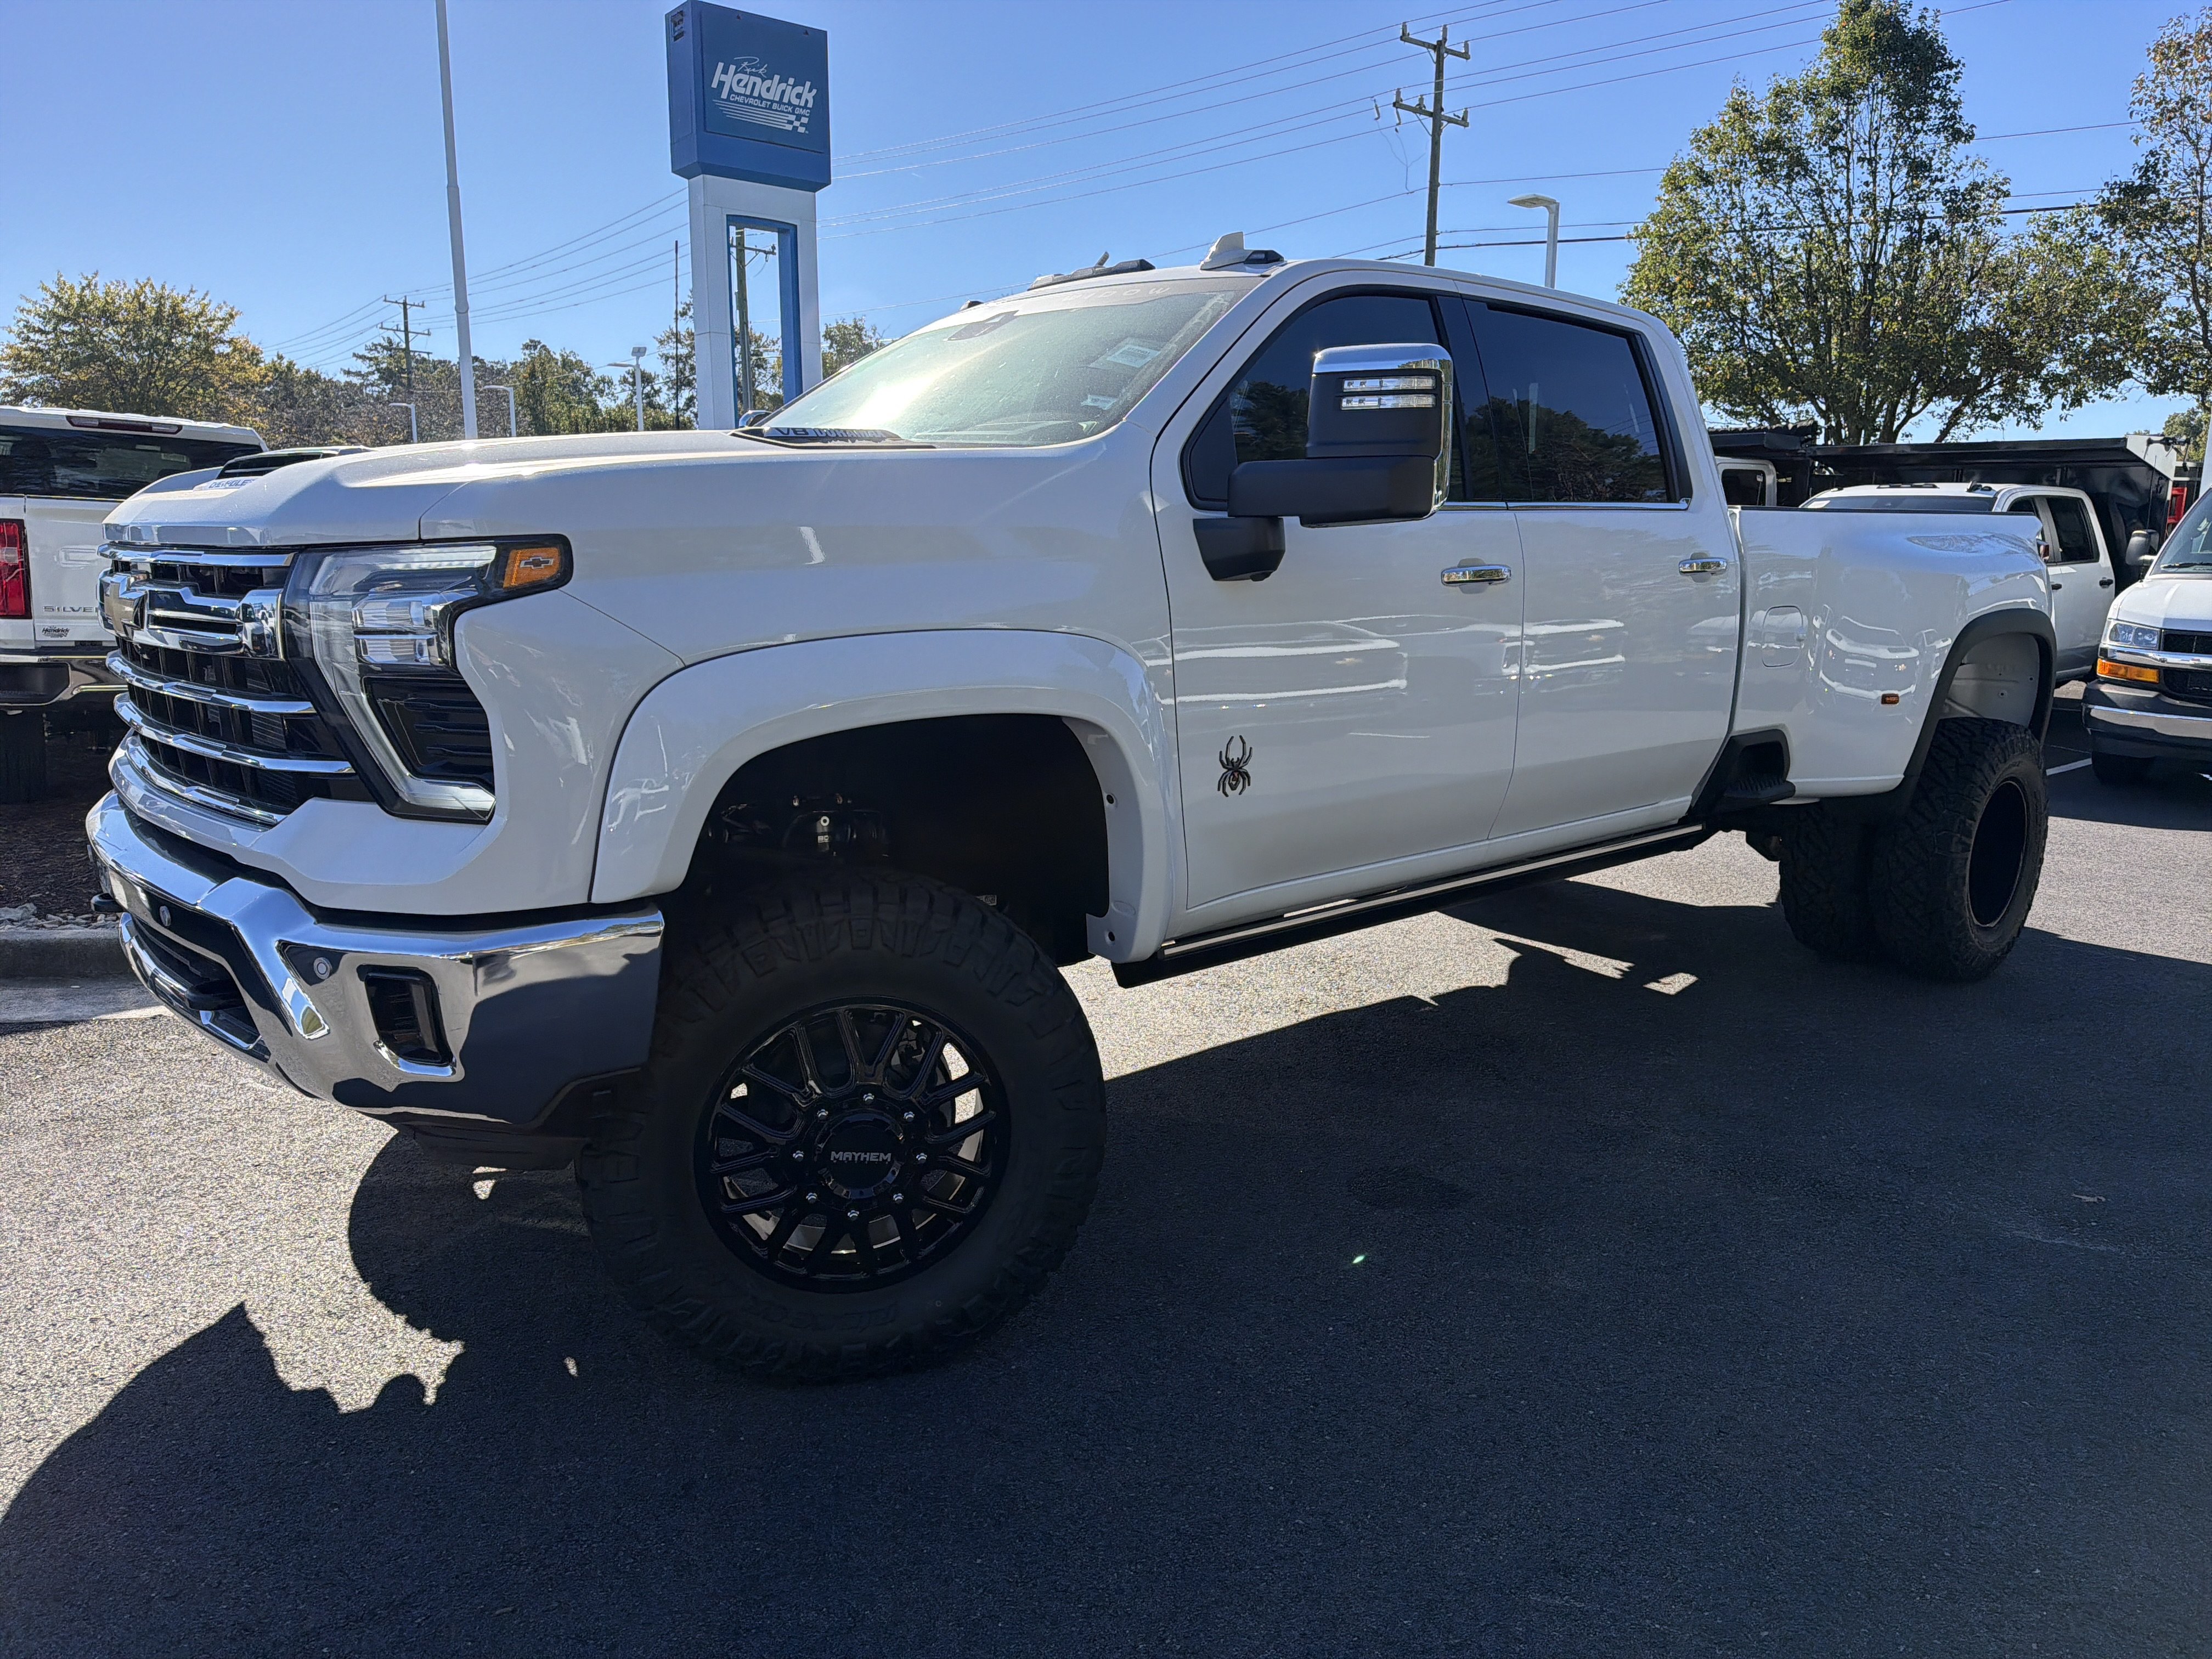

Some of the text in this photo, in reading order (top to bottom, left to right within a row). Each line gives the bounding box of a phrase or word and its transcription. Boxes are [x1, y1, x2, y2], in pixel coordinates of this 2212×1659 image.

[733, 56, 768, 78] Rick
[712, 62, 817, 108] Hendrick
[730, 94, 810, 116] CHEVROLET BUICK GMC
[774, 427, 887, 438] V8 DURAMAX
[830, 1151, 891, 1163] MAYHEM
